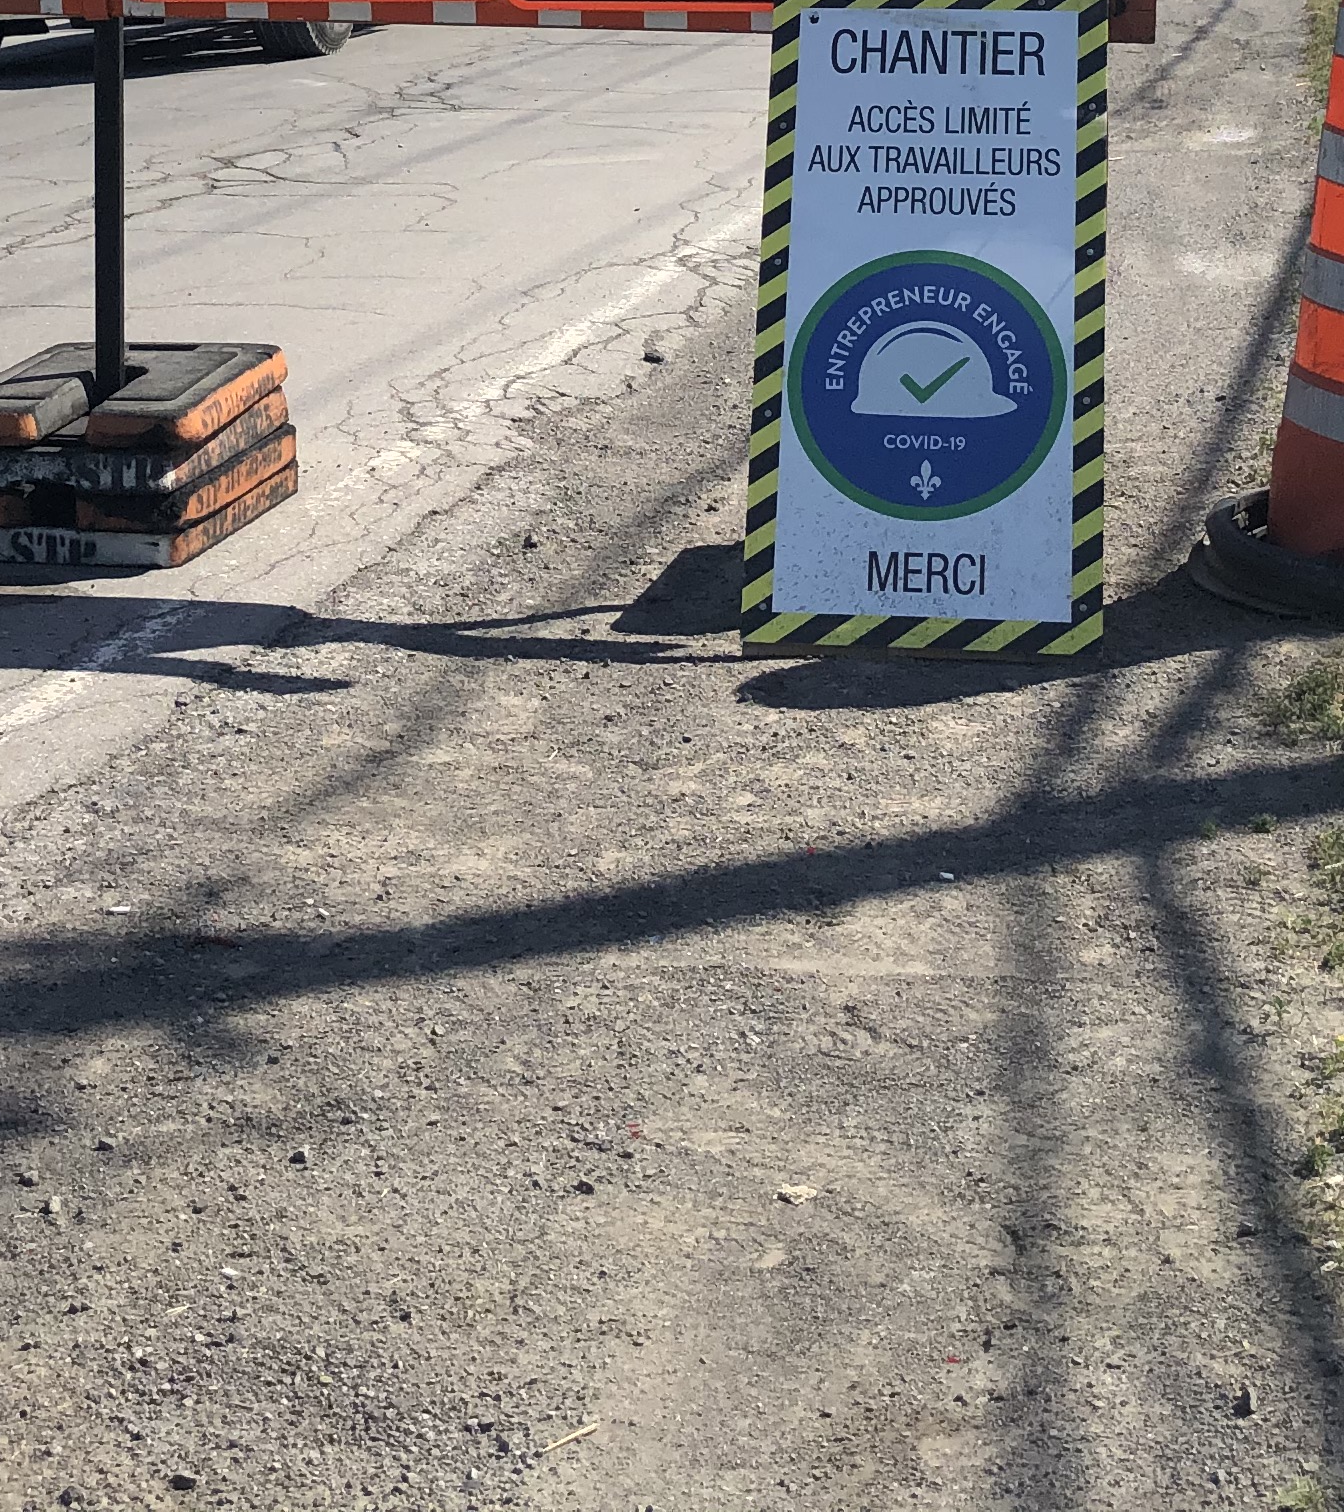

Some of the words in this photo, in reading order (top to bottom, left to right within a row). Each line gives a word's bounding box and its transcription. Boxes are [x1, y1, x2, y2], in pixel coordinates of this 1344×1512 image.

[831, 29, 1045, 76] CHANTIER
[848, 100, 935, 134] ACCÈS
[945, 101, 1031, 135] LIMITÉ
[808, 145, 861, 173] AUX
[868, 146, 1061, 177] TRAVAILLEURS
[857, 182, 1016, 216] APPROUVÉS
[826, 286, 971, 390] ENTREPRENEUR
[973, 304, 1034, 395] ENGAGÉ
[883, 434, 967, 451] COVID-19
[867, 551, 985, 595] MERCI
